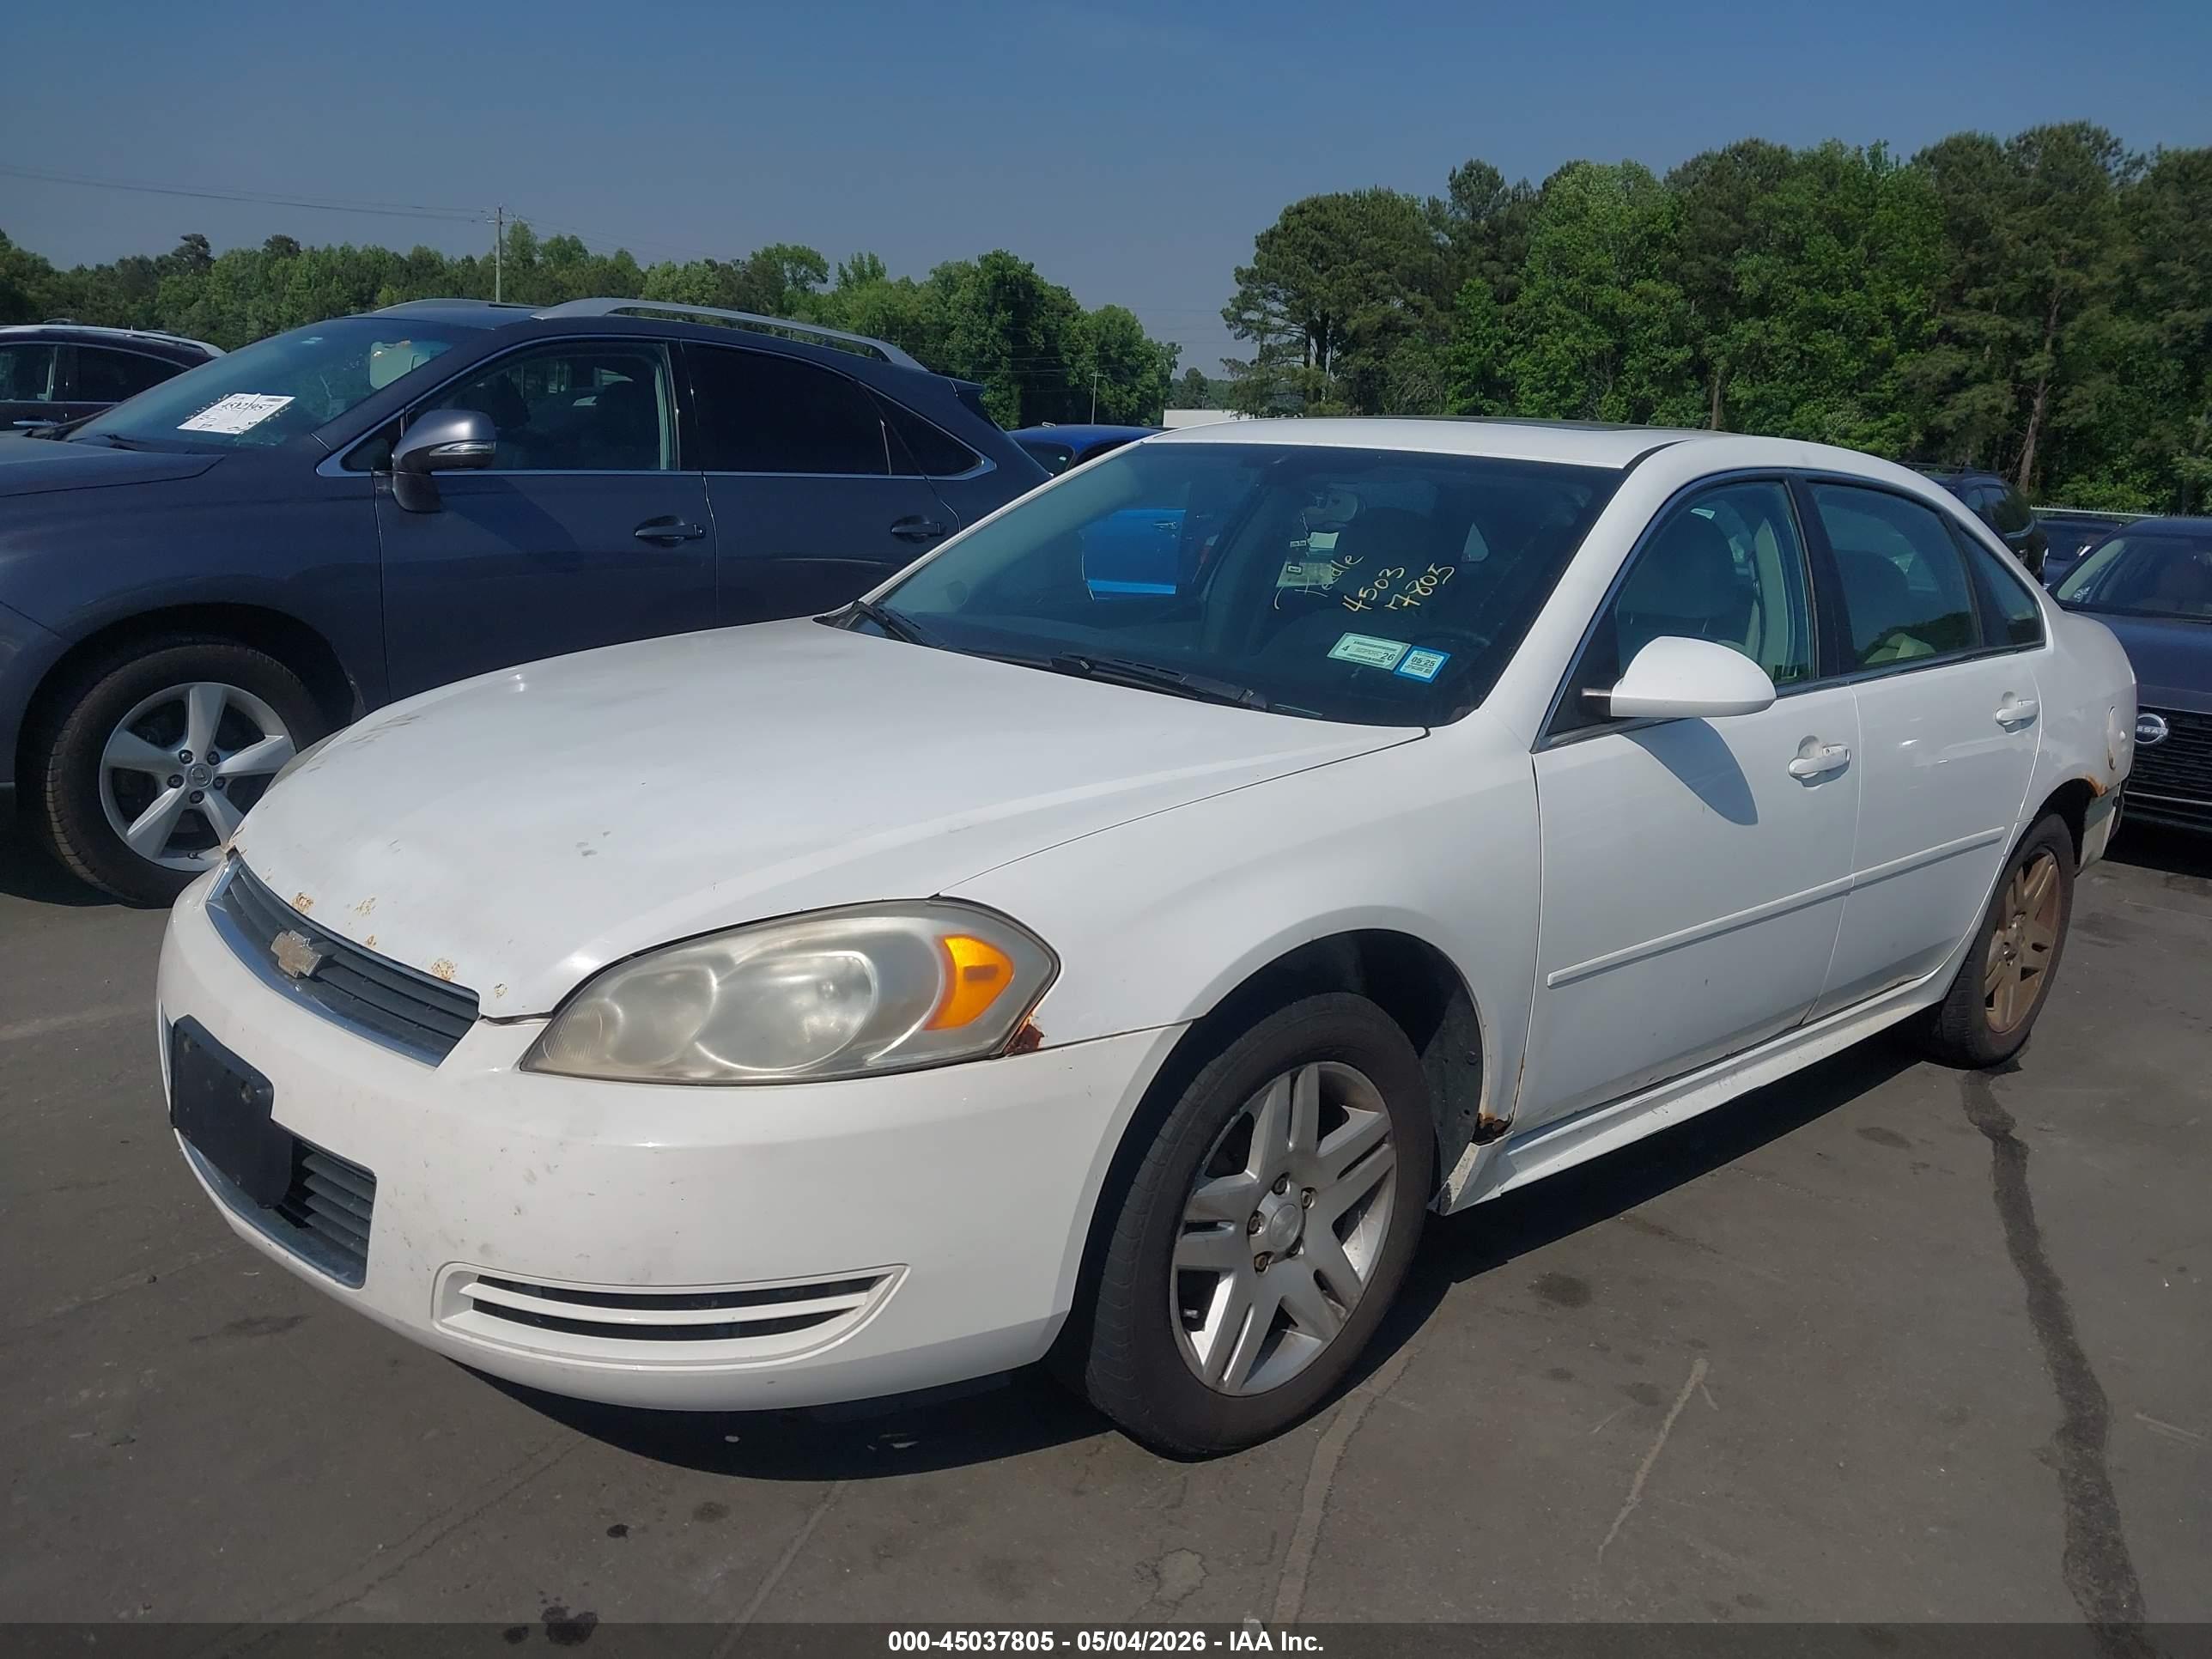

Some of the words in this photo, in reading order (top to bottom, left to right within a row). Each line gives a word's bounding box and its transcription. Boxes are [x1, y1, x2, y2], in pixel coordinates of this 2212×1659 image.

[1341, 566, 1406, 612] 4503
[1380, 652, 1395, 661] 26
[2136, 726, 2168, 735] SSAN
